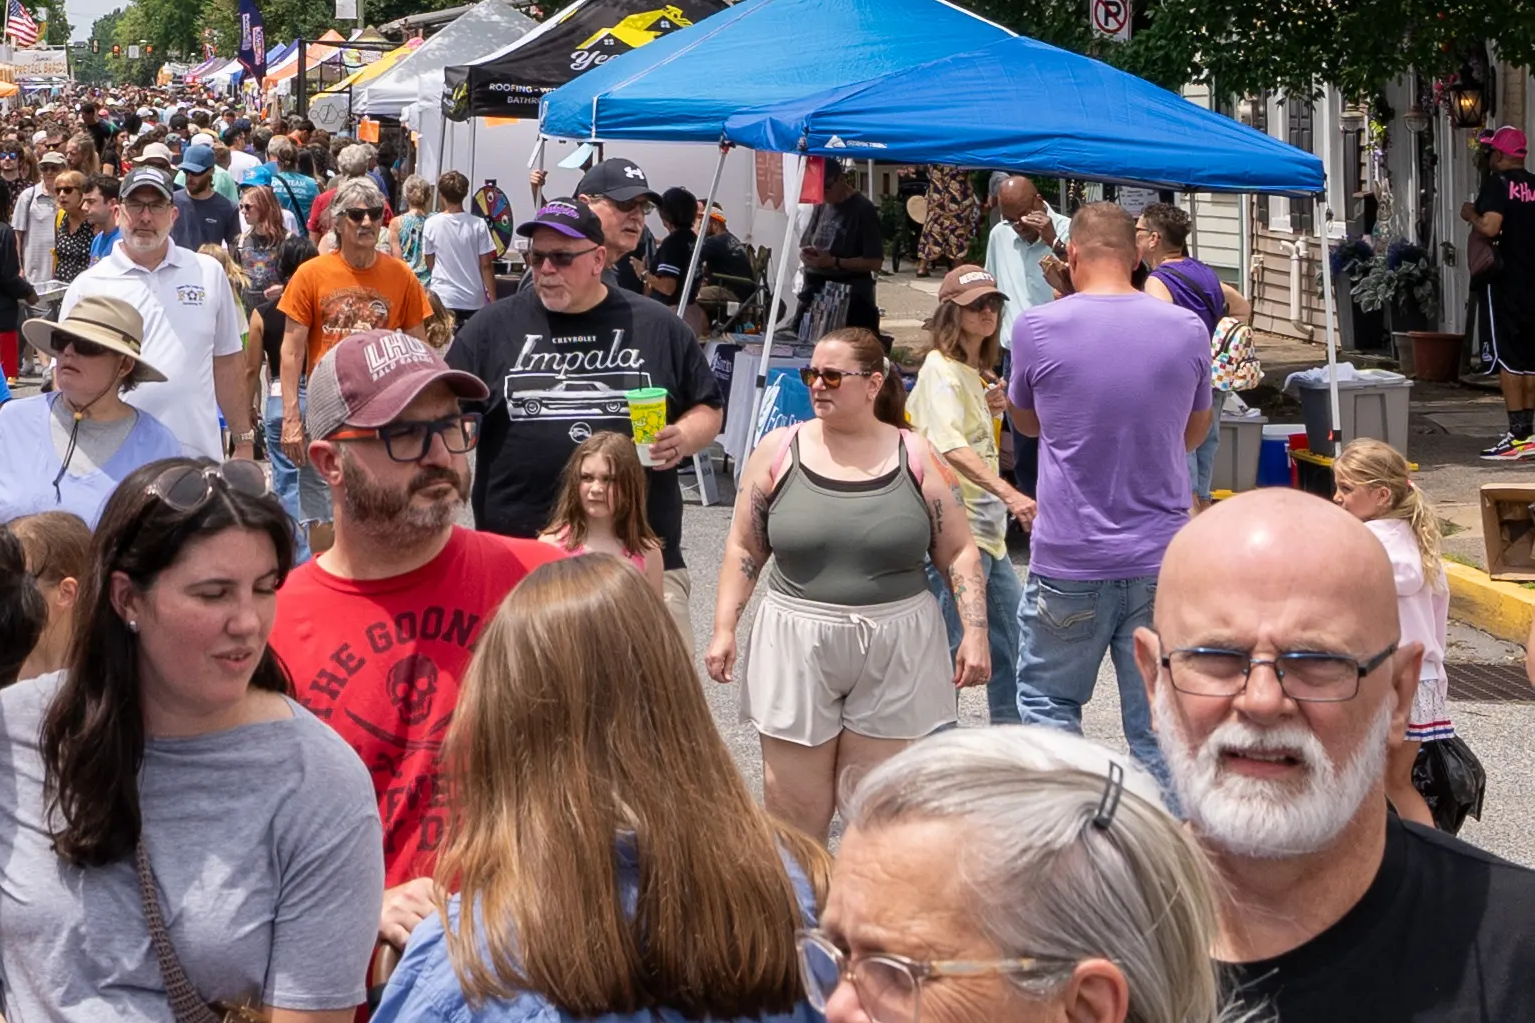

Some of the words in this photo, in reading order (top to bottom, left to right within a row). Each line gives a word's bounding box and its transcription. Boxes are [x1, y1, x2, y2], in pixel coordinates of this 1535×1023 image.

[489, 83, 533, 93] ROOFING
[364, 333, 429, 374] LHU
[509, 329, 645, 379] Impala
[551, 336, 597, 344] CHEVROLET
[365, 606, 481, 655] GOON
